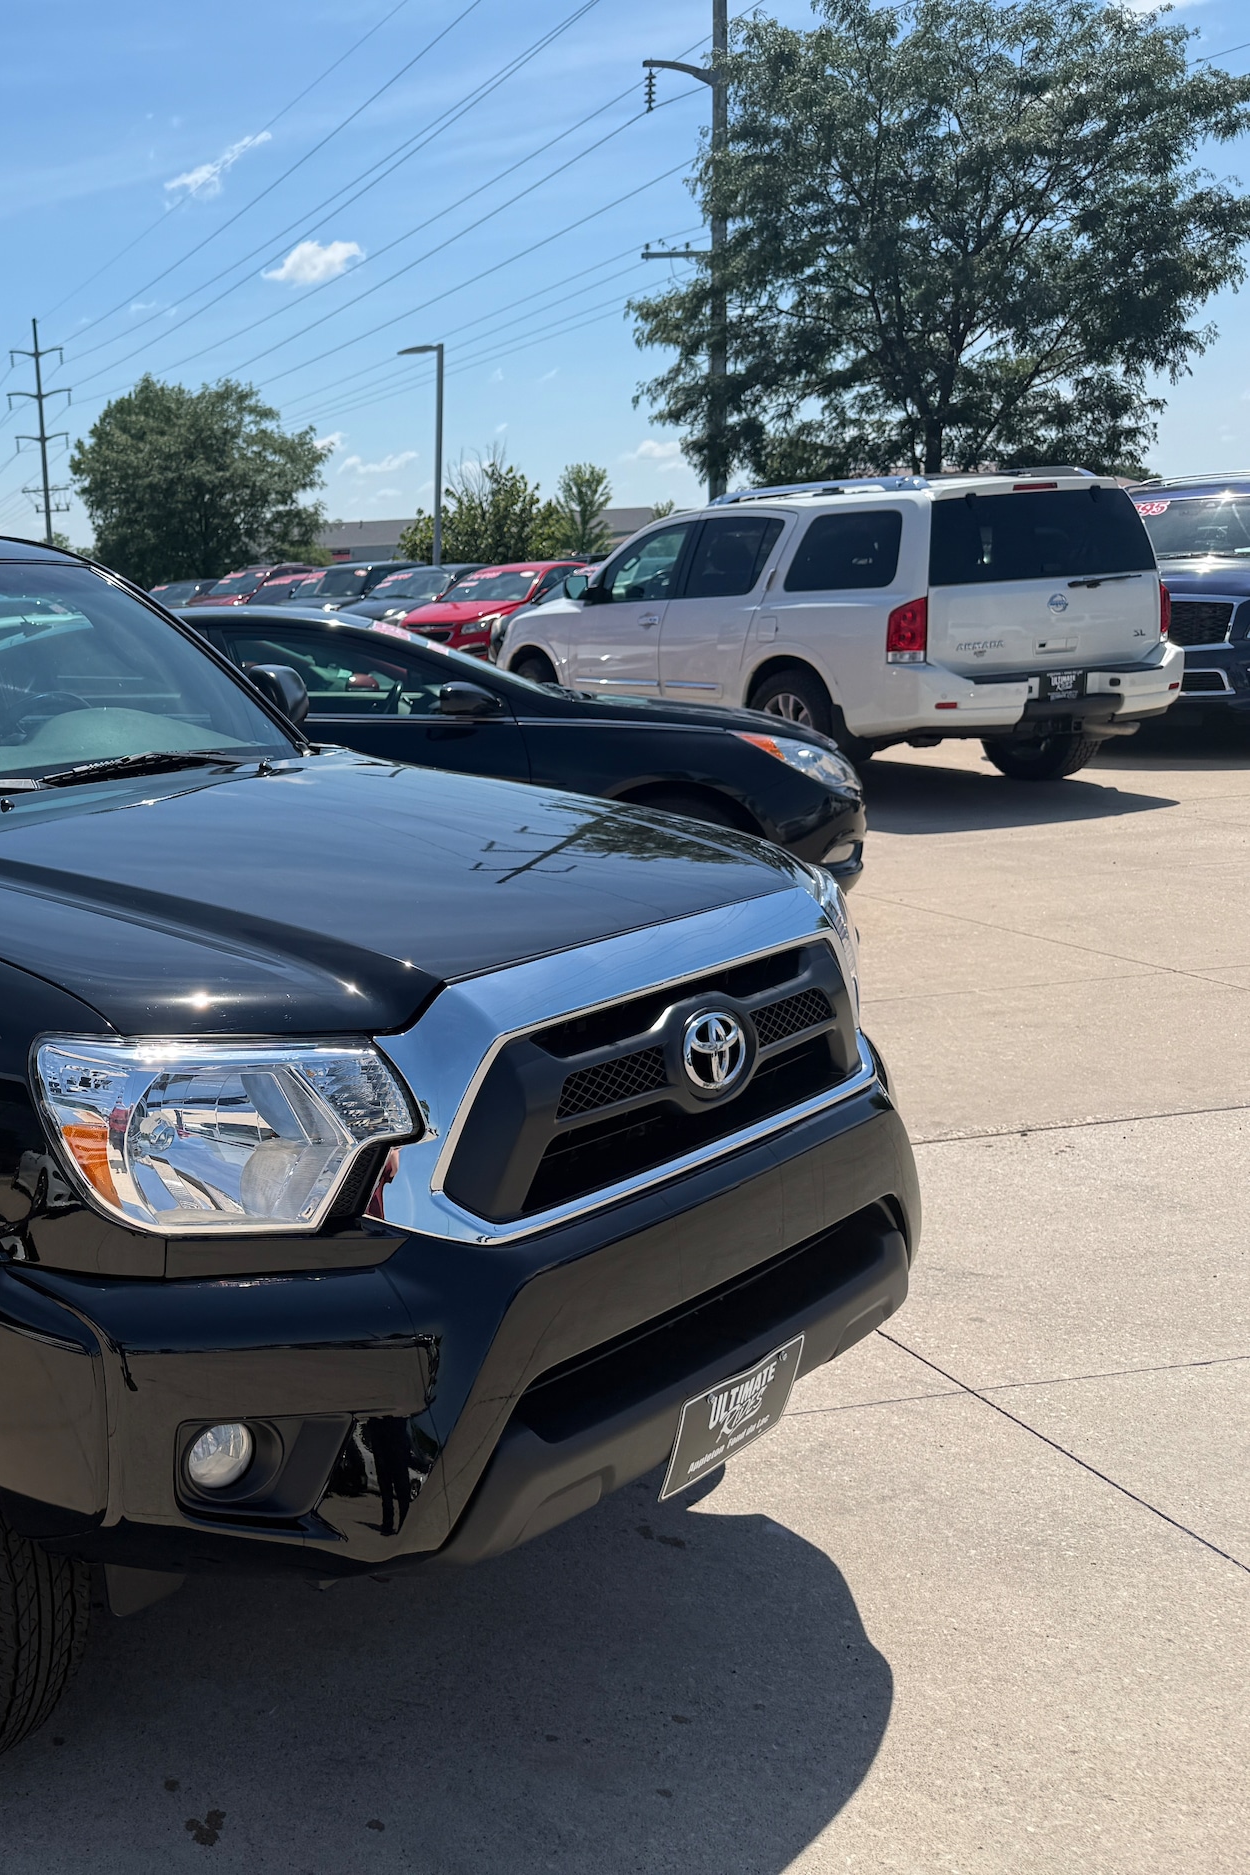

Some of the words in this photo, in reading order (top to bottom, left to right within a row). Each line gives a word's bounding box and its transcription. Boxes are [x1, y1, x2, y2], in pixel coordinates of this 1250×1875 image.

[956, 640, 1004, 652] ARMADA
[708, 1361, 777, 1430] ULTIMATE
[715, 1384, 767, 1443] RIDES
